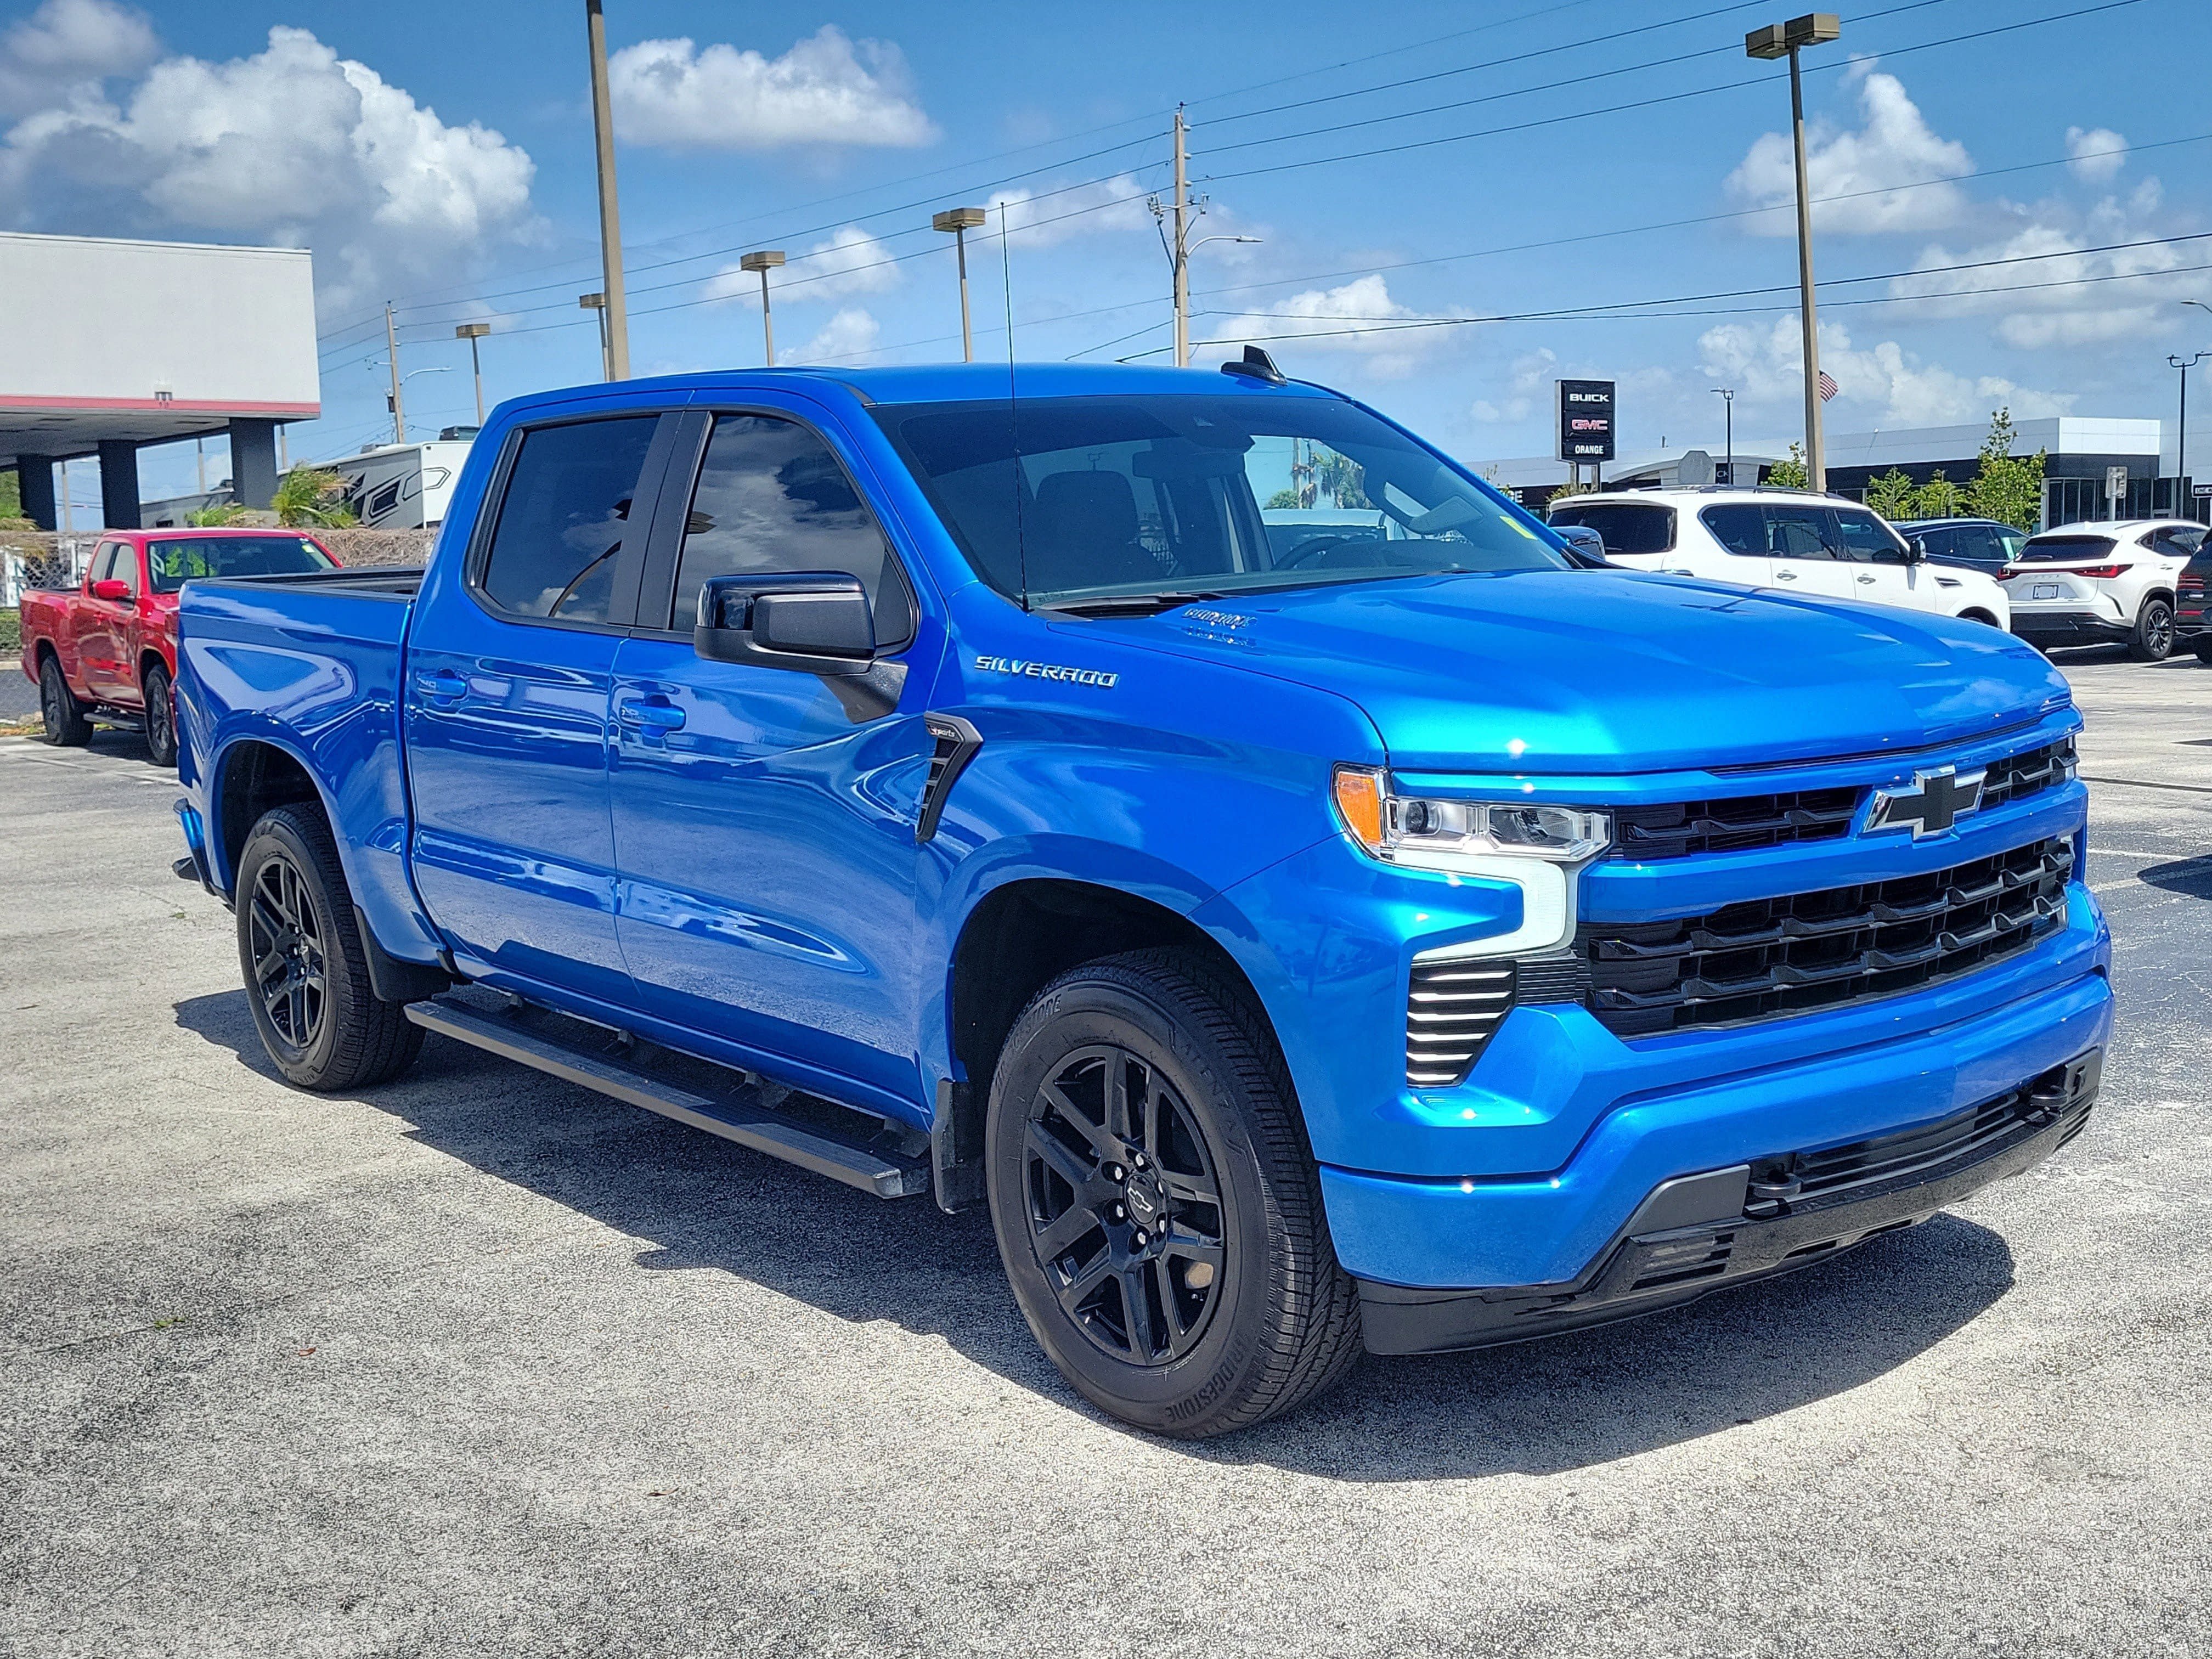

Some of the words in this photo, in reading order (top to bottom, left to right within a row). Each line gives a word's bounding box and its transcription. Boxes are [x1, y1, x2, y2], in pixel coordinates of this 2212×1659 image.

[1570, 393, 1609, 402] BUICK
[1572, 420, 1607, 430] GMC
[1575, 445, 1604, 454] ORANGE
[974, 656, 1119, 687] SILVERADO
